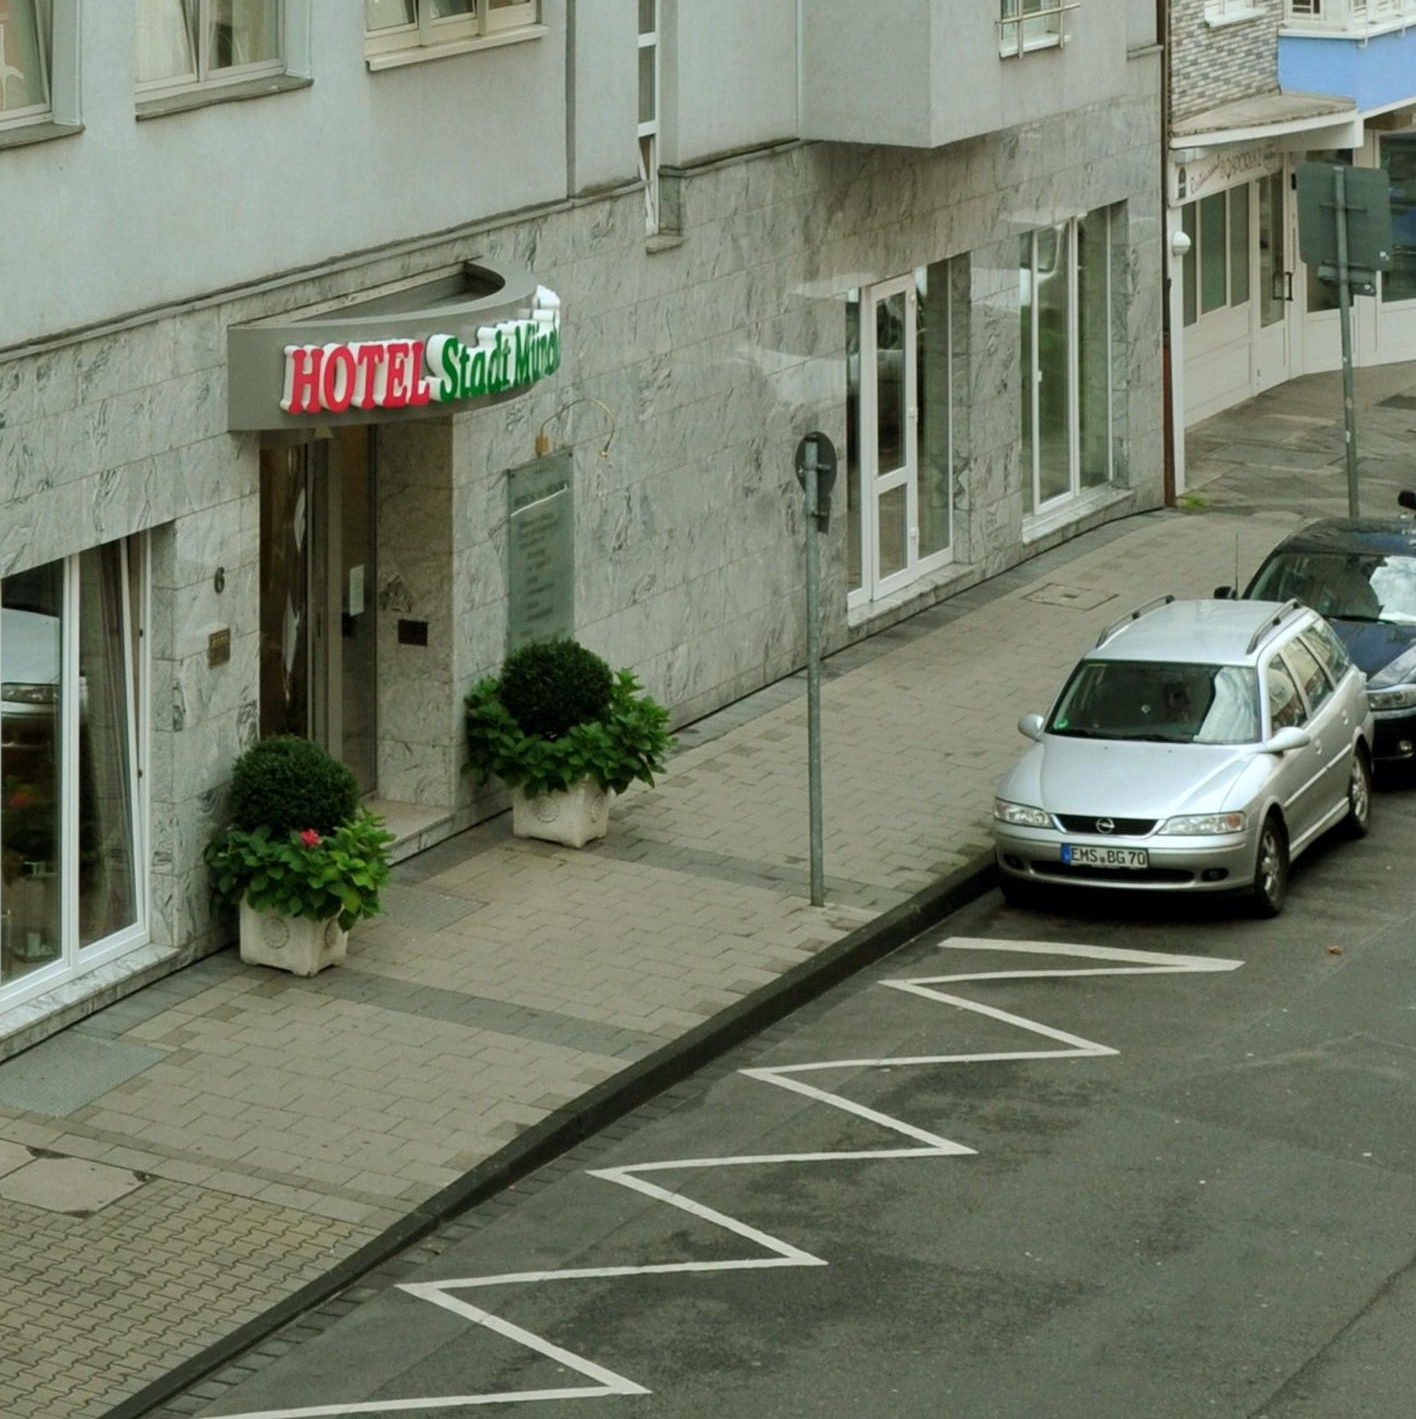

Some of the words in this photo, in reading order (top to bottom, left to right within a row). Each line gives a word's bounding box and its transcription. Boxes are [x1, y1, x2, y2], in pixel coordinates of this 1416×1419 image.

[284, 340, 430, 415] HOTEL
[434, 329, 511, 403] Stadt
[214, 566, 225, 595] 6
[1071, 847, 1098, 863] EMS
[1107, 849, 1126, 864] BG
[1128, 851, 1146, 865] 70
